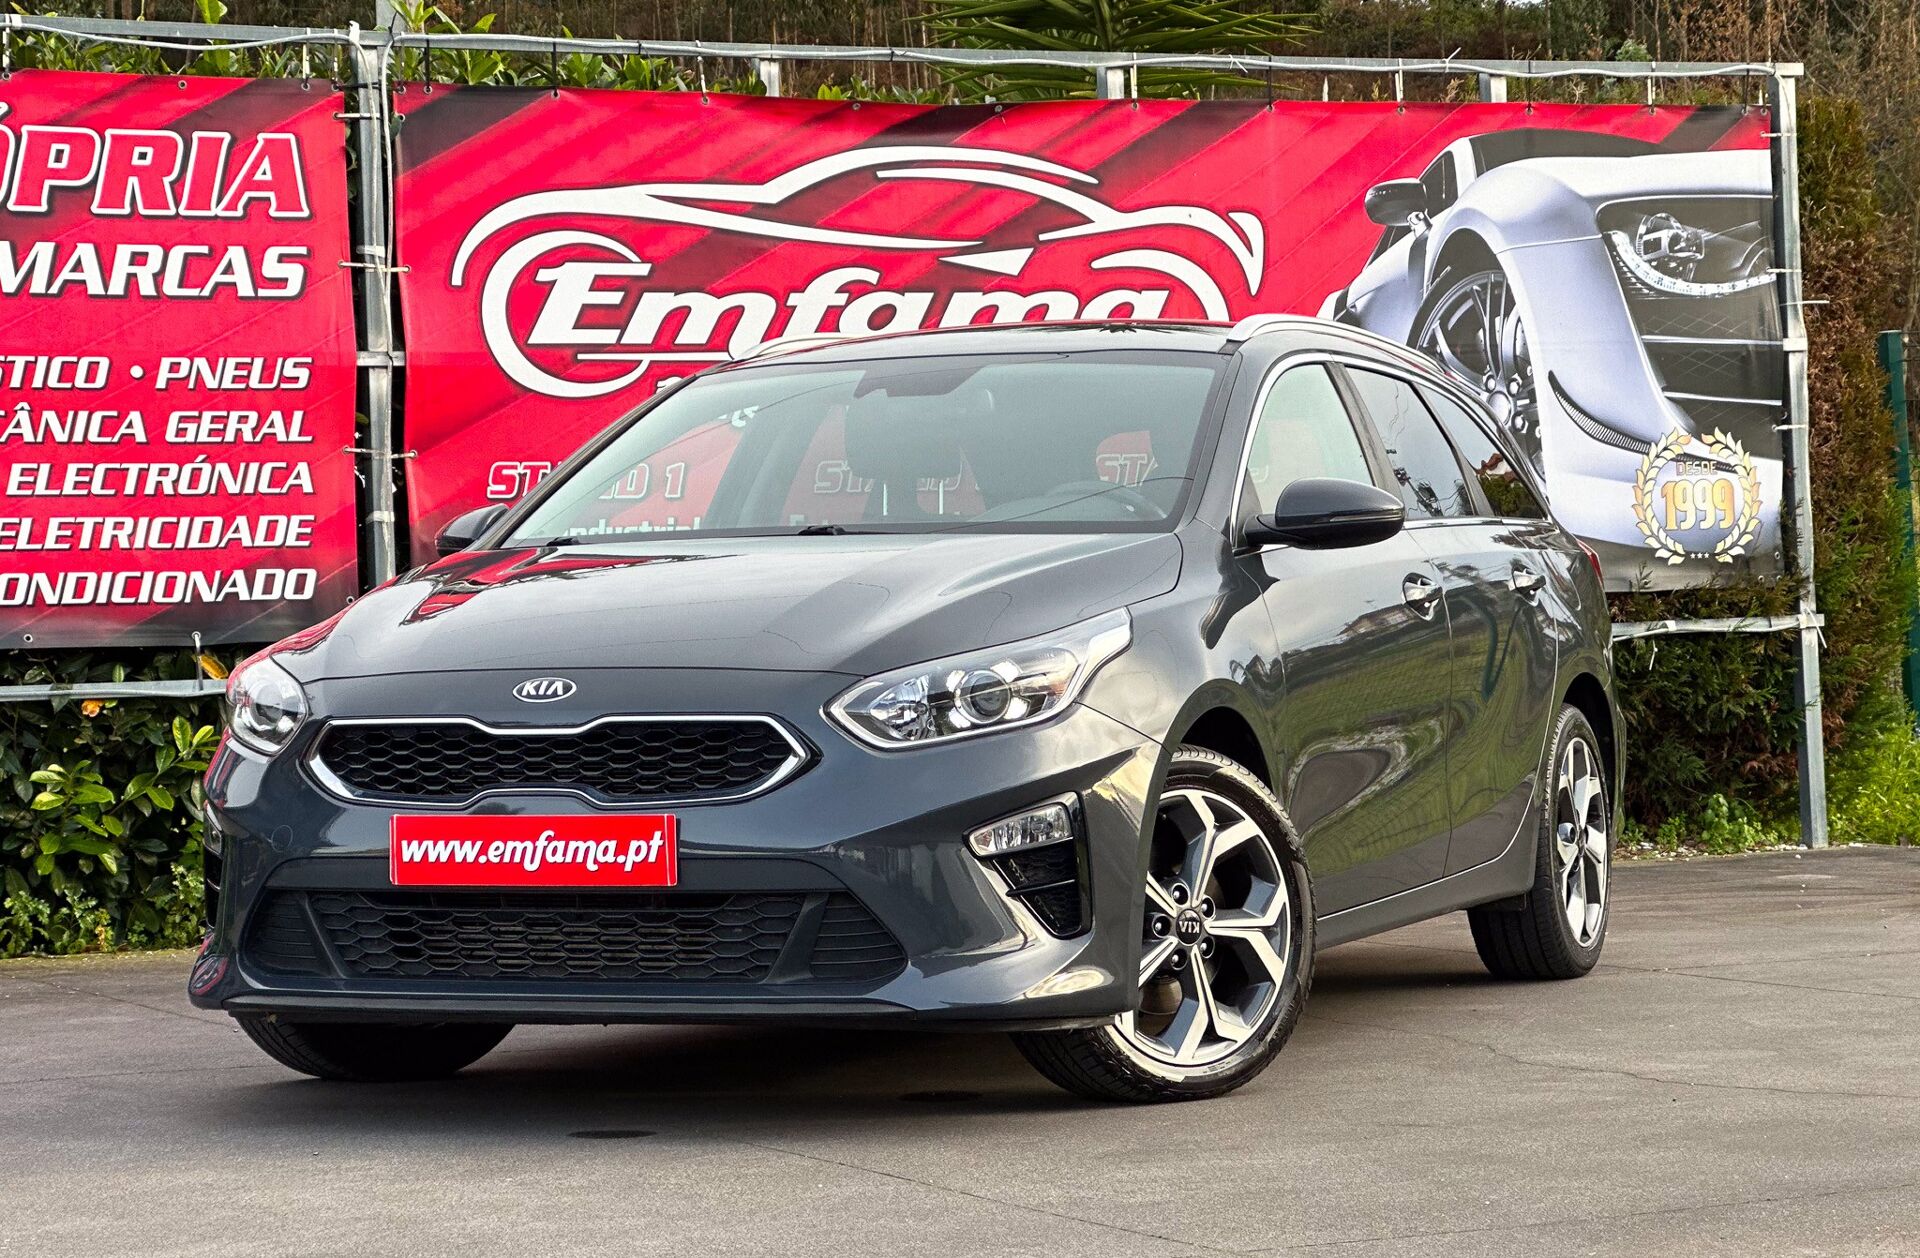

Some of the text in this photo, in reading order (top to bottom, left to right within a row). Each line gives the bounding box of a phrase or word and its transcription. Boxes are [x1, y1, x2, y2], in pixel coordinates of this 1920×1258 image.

[0, 101, 310, 217] PRIA
[0, 240, 308, 297] MARCAS
[0, 355, 313, 390] TICO PNEUS
[0, 401, 313, 443] ÂNICA GERAL
[6, 454, 314, 496] ELECTRÓNICA
[1676, 461, 1718, 476] DESDE
[1660, 478, 1735, 531] 1999
[0, 514, 315, 550] ELETRICIDADE
[521, 680, 564, 696] KIA
[401, 829, 664, 873] www.emfama.pt
[1179, 921, 1200, 934] KIA
